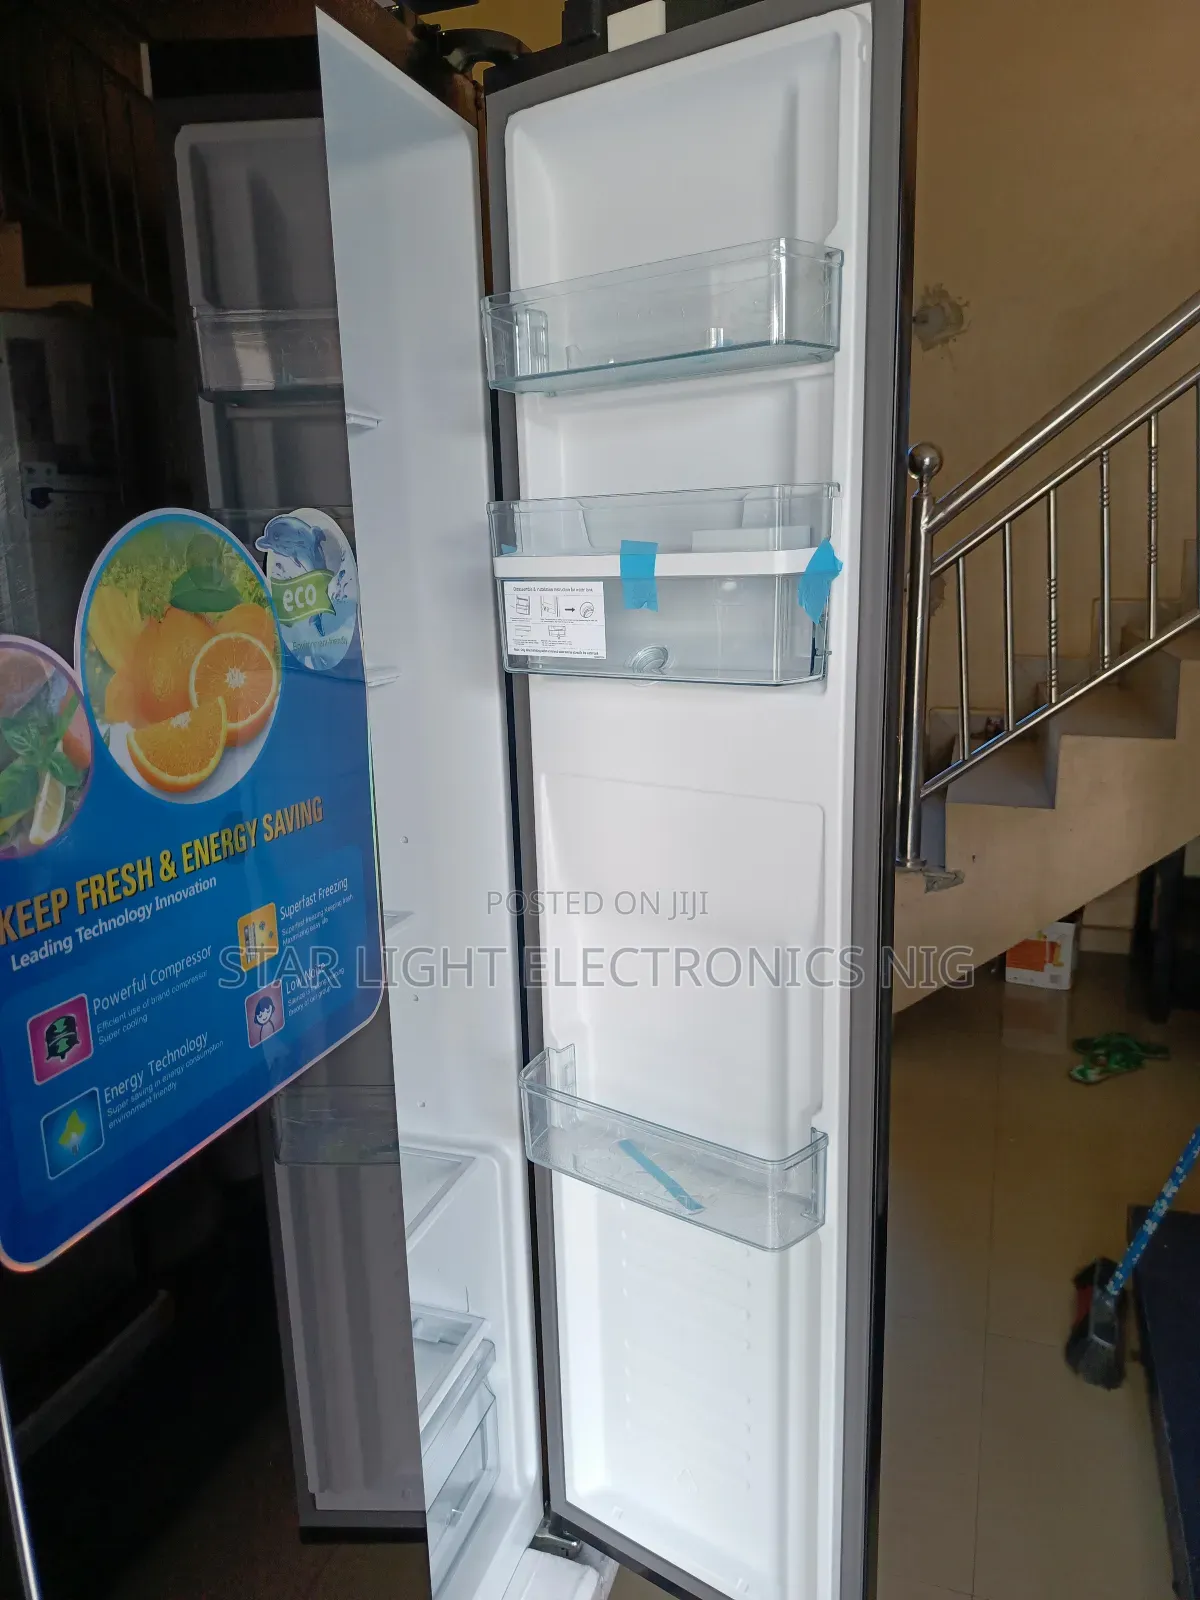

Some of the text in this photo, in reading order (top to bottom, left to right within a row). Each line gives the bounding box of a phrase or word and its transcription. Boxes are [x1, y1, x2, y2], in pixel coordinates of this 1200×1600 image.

[282, 584, 317, 612] eco
[0, 796, 325, 945] KEEP FRESH & ENERGY SAVING
[279, 877, 348, 921] Superfast Freezing
[10, 876, 218, 972] Leading Technology Innovation
[93, 944, 212, 1016] Powerful Compressor
[96, 969, 208, 1034] Efficient use of brand compressor
[285, 974, 305, 995] Low
[98, 1013, 148, 1046] Super cooling
[103, 1031, 208, 1105] Energy Technology
[106, 1099, 129, 1118] Super
[130, 1083, 154, 1103] saving
[161, 1064, 185, 1083] energy
[184, 1039, 225, 1068] consumption
[108, 1080, 177, 1130] environment friendly
